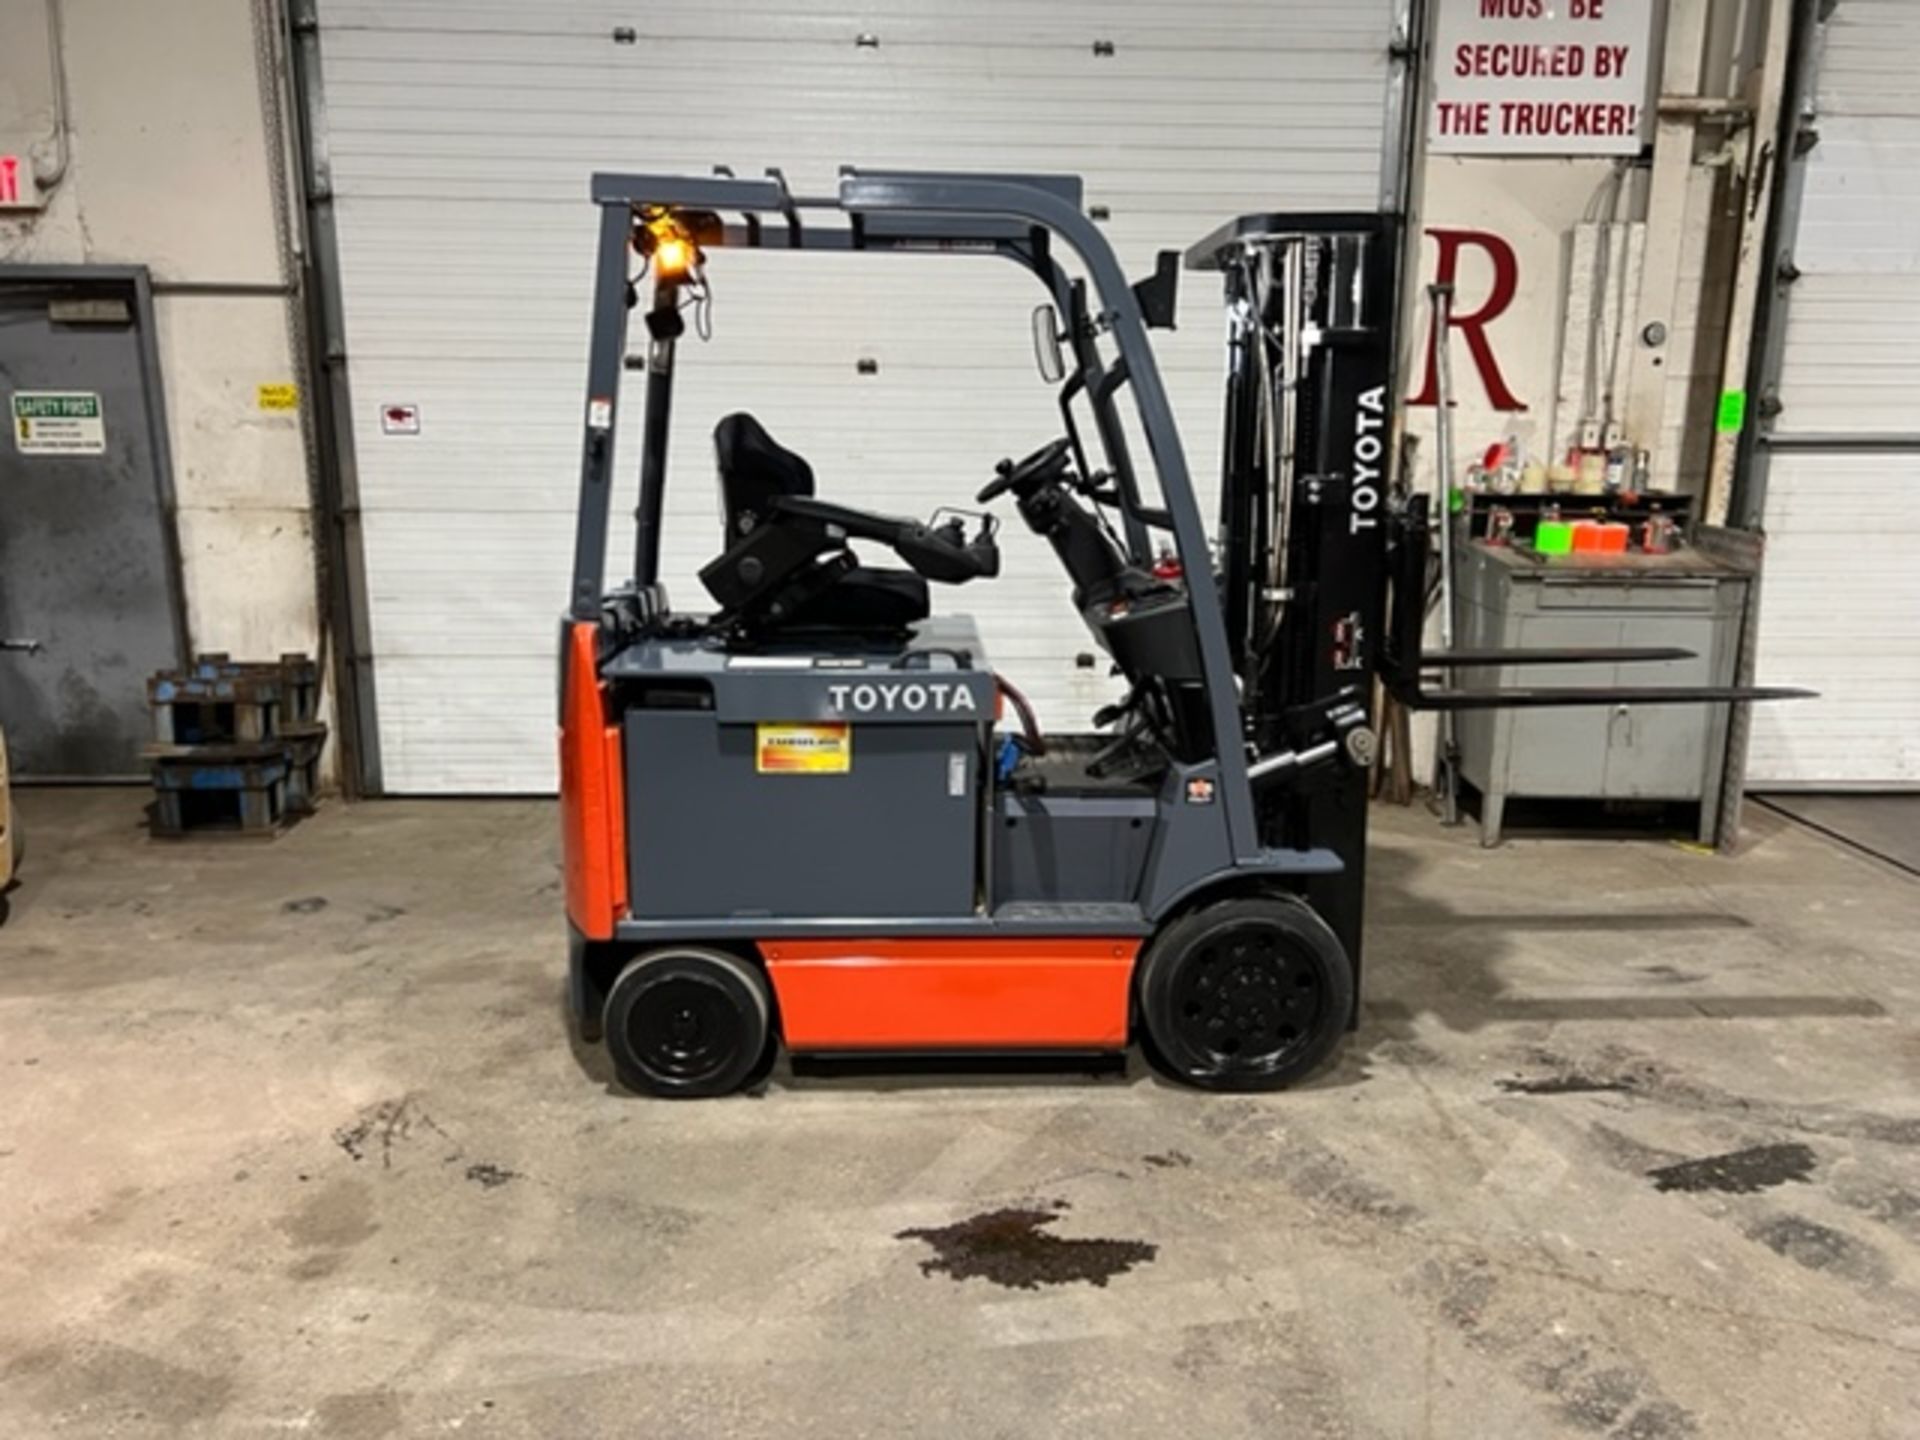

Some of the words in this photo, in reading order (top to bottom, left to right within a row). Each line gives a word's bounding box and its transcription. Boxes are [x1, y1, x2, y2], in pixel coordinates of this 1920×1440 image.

[1455, 44, 1585, 77] SECURED
[1594, 45, 1629, 77] BY
[1437, 103, 1490, 135] THE
[1500, 103, 1636, 136] TRUCKER!
[1403, 228, 1529, 412] R
[1350, 385, 1386, 535] TOYOTA
[828, 684, 976, 711] TOYOTA
